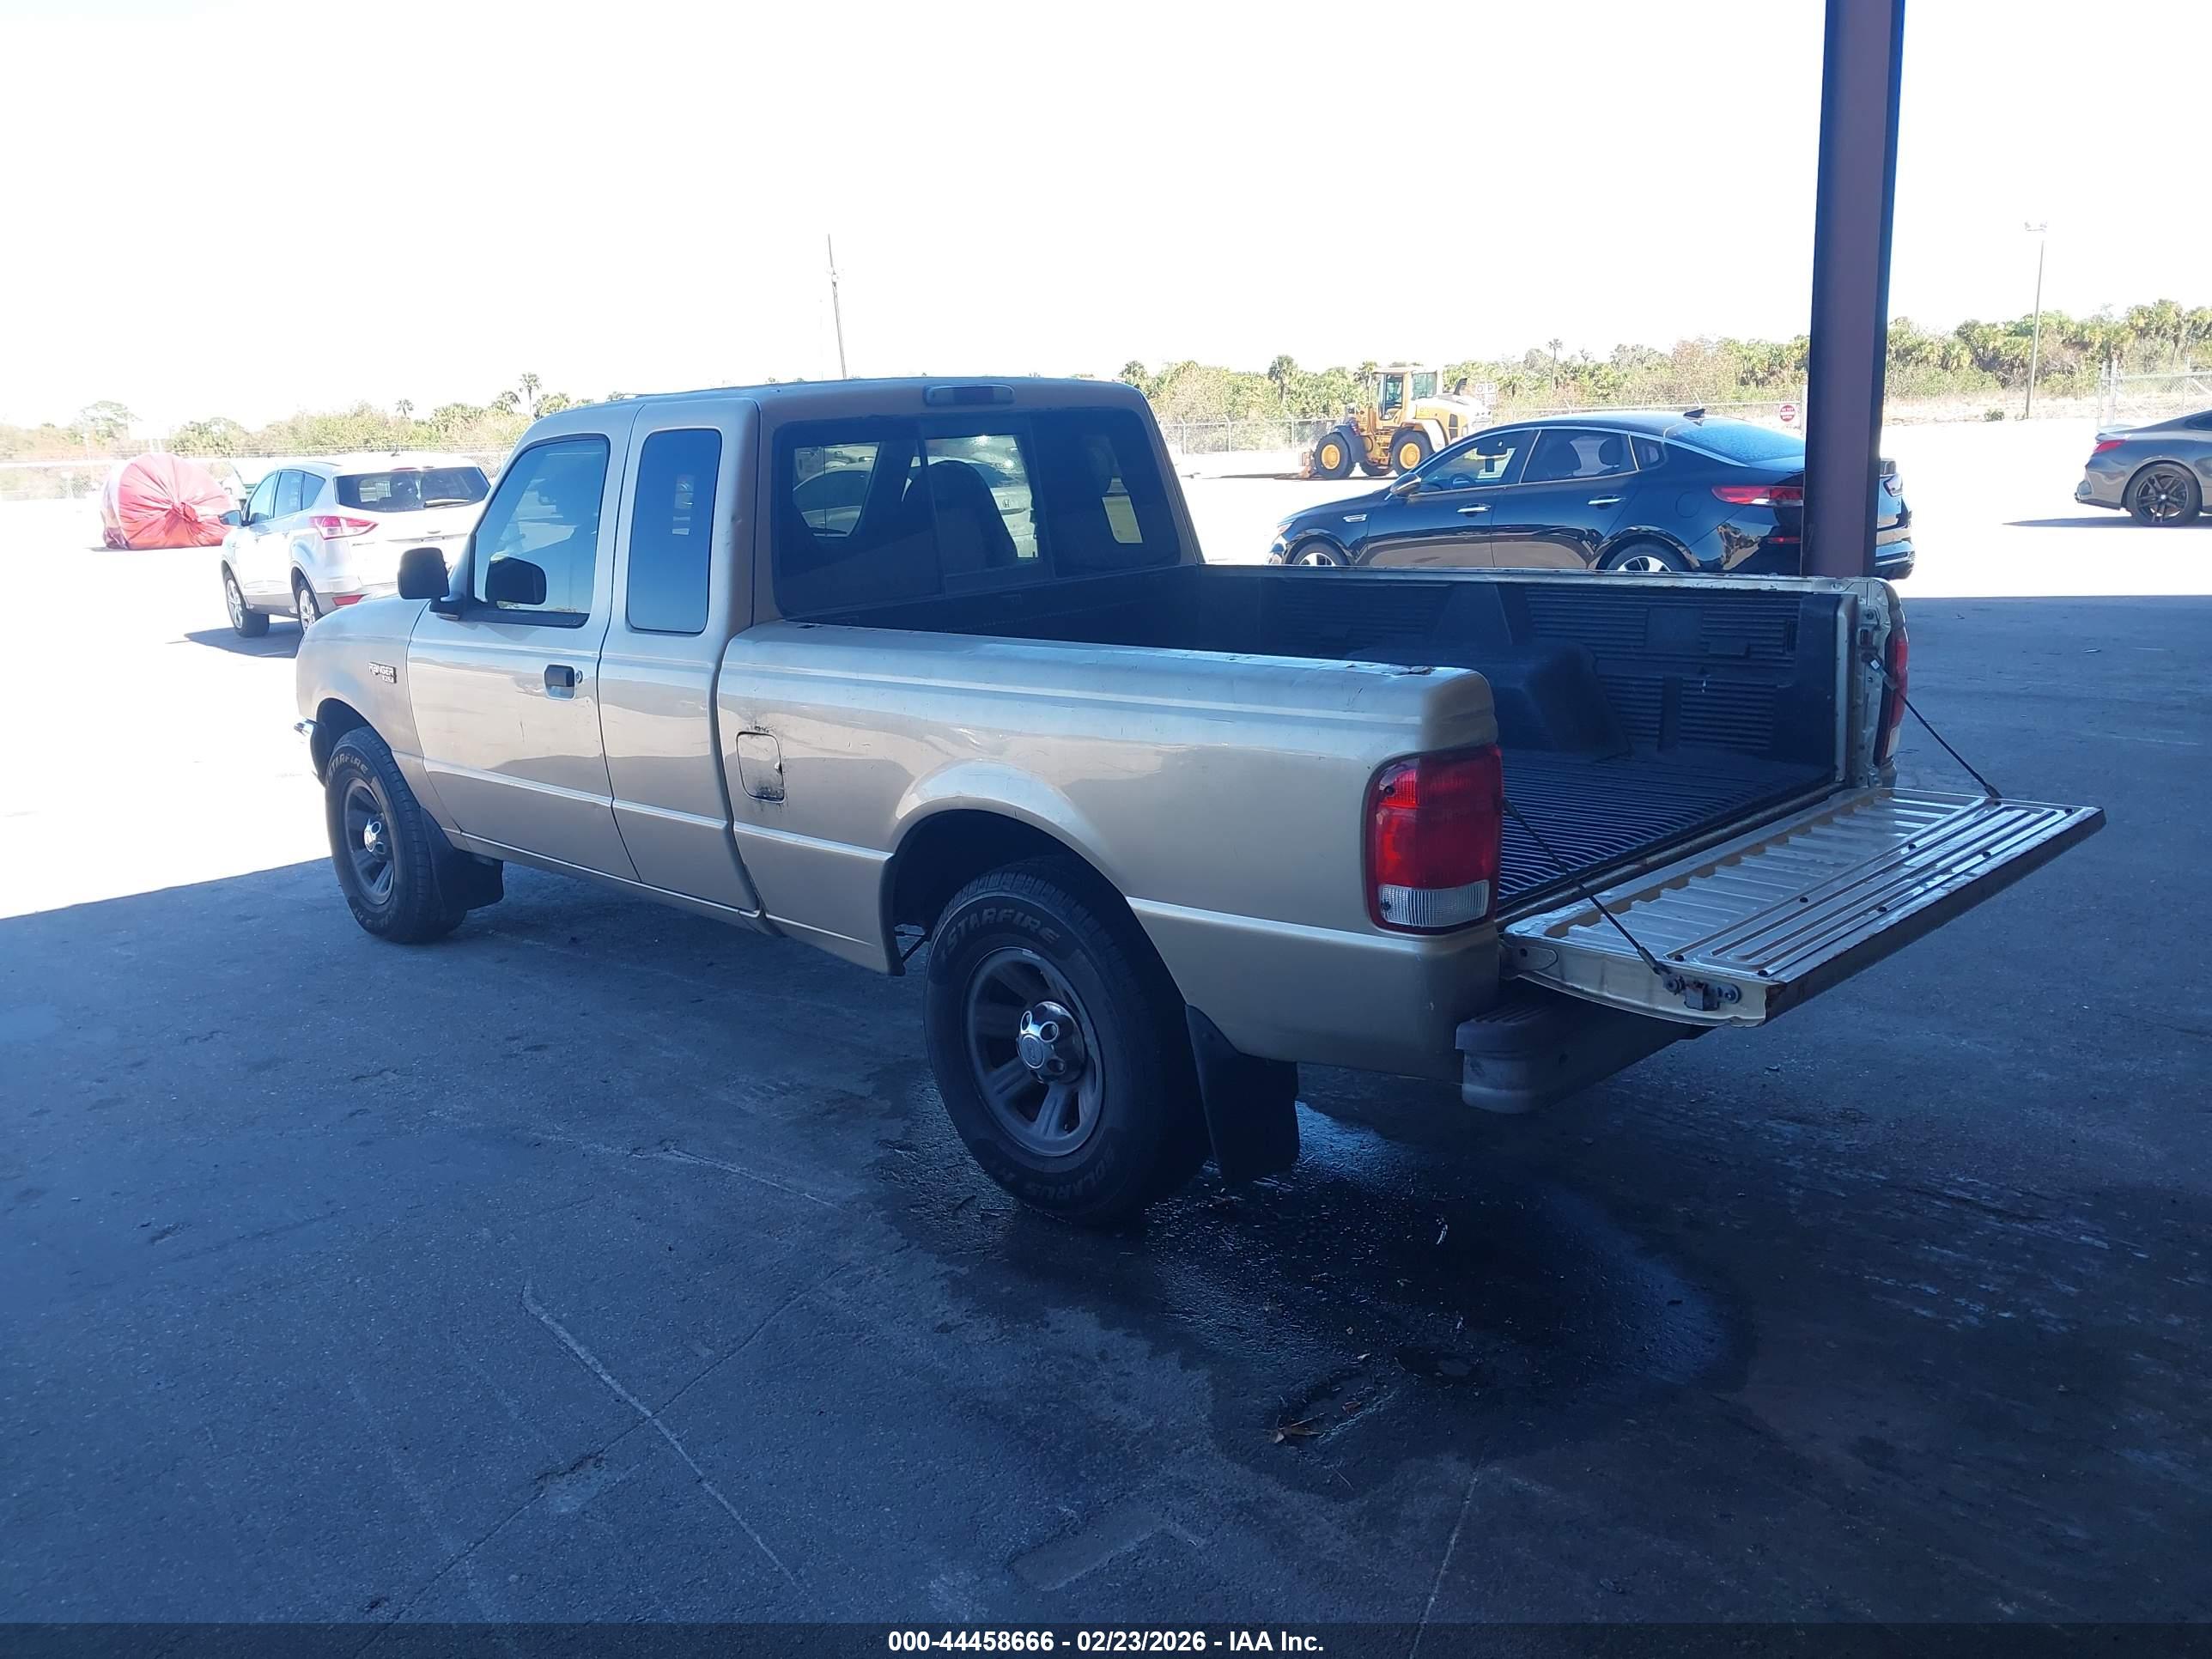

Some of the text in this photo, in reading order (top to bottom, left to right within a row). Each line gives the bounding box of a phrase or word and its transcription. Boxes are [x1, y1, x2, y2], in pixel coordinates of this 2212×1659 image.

[368, 662, 395, 676] RANGER
[328, 753, 368, 781] STARFIRE
[947, 907, 1061, 954] STARFIRE
